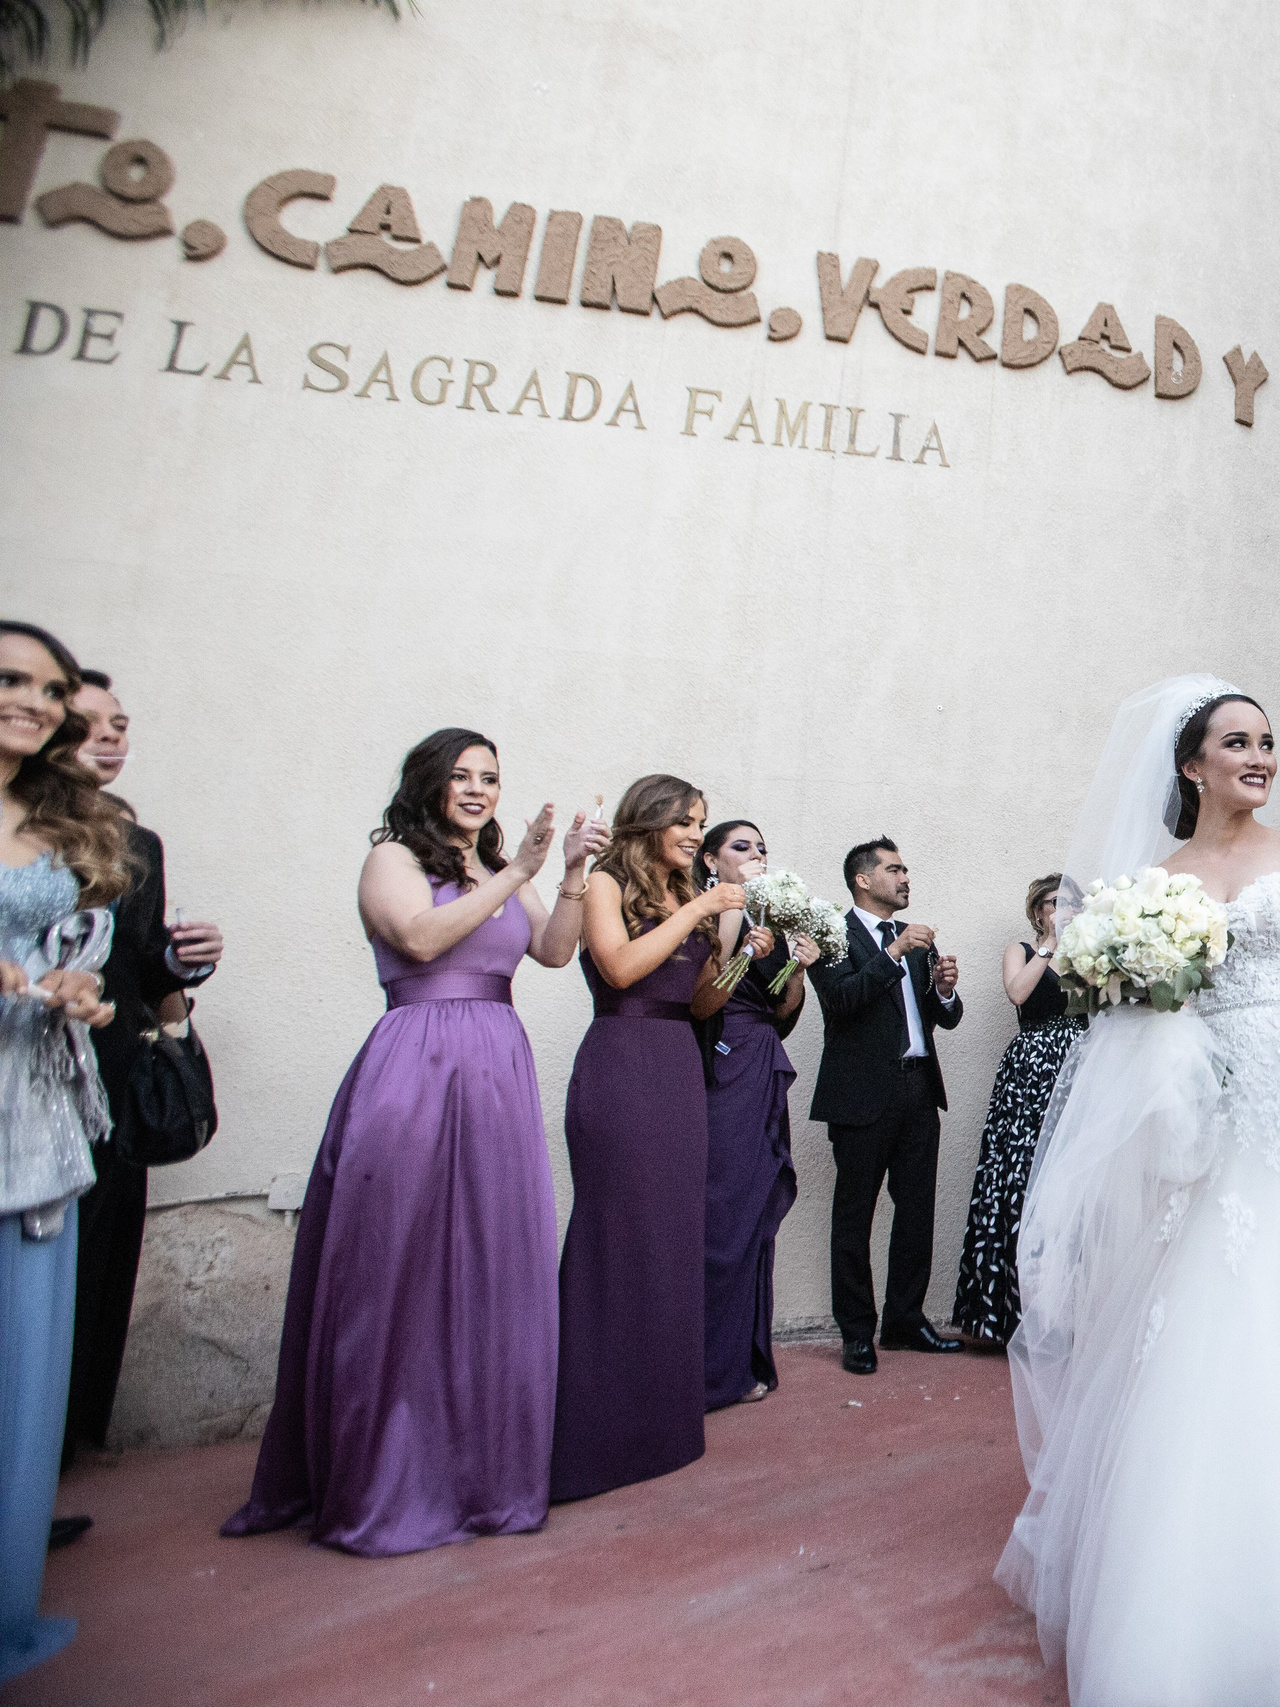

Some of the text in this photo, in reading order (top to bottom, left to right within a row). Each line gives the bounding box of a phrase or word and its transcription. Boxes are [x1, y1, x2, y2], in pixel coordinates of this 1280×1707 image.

[15, 301, 951, 467] DE LA SAGRADA FAMILIA
[816, 251, 1202, 399] VERDAD
[1223, 345, 1269, 427] Y
